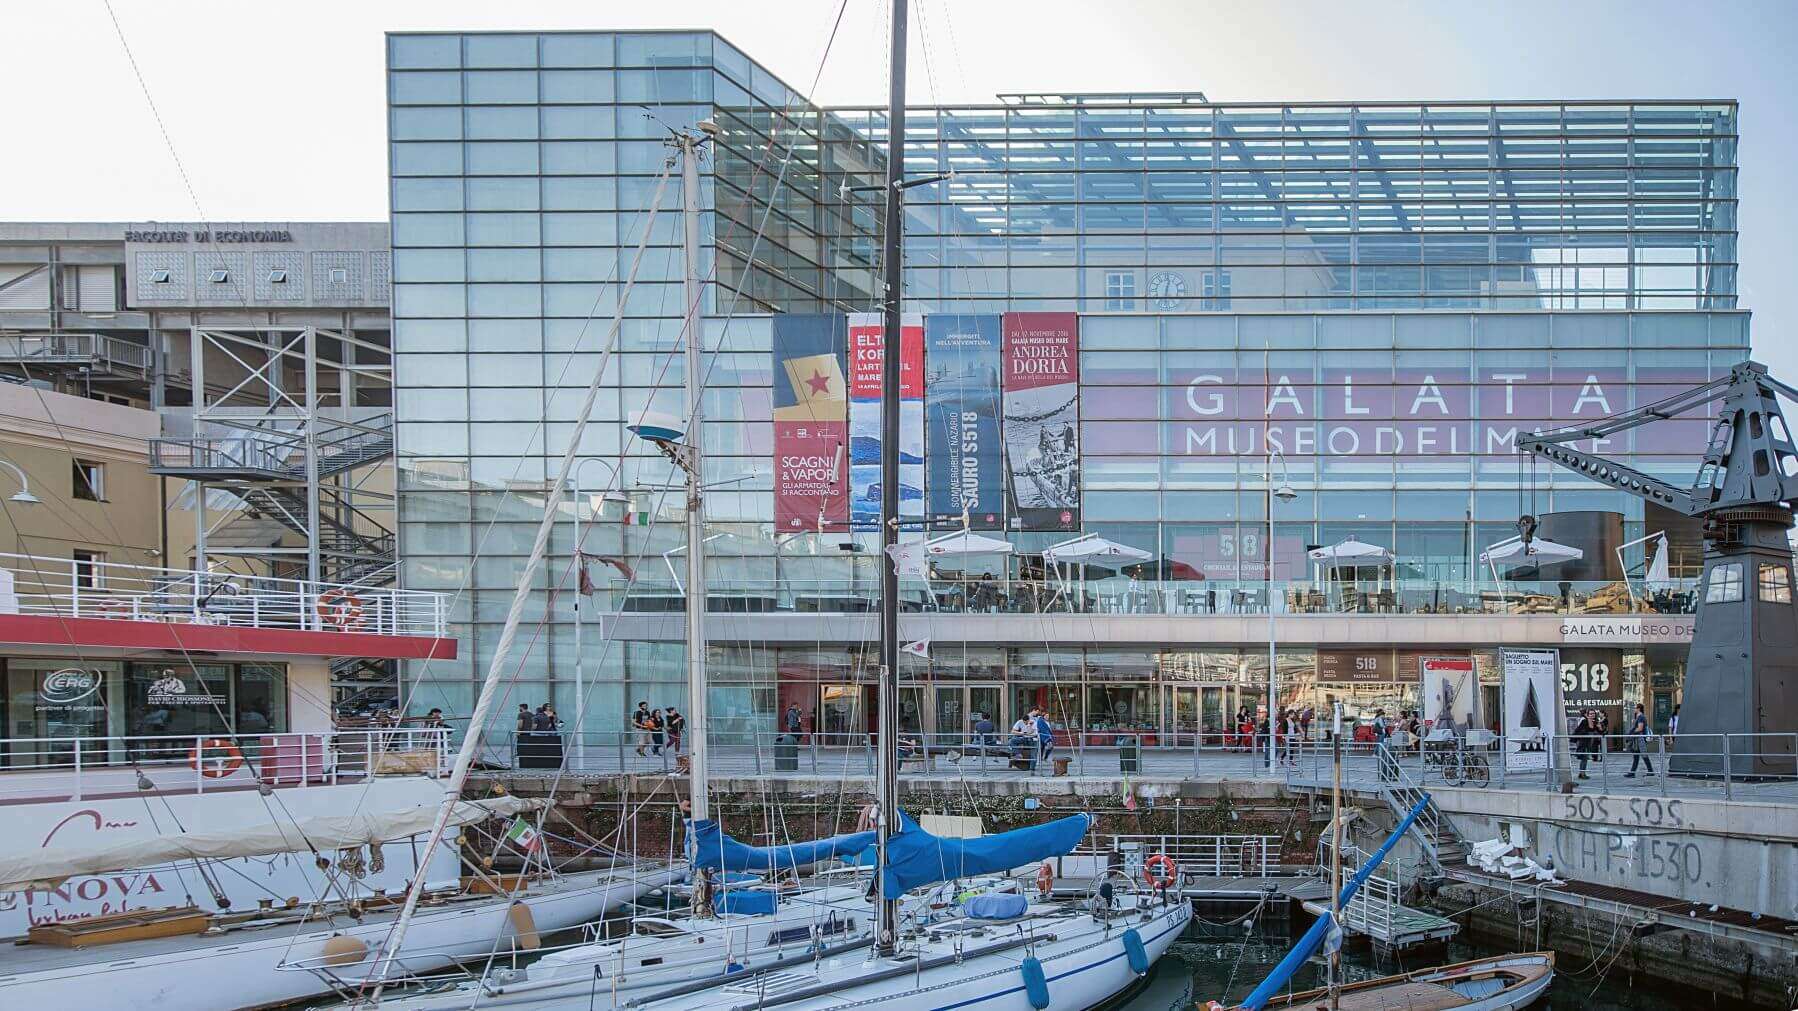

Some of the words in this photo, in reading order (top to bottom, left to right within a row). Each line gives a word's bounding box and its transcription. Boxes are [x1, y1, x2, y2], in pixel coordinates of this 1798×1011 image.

[194, 231, 209, 242] DI
[216, 231, 293, 242] ECONOMIA
[1012, 346, 1069, 358] ANDREA
[1013, 358, 1070, 374] DORIA
[1187, 375, 1611, 415] GALATA
[950, 412, 959, 446] NAZARIO
[1487, 427, 1612, 454] MRE
[782, 456, 834, 468] SCAGNI
[782, 471, 790, 481] &
[951, 449, 959, 508] SOMMERGIBILE
[962, 457, 979, 509] SAURO
[1219, 534, 1258, 557] 58
[1560, 624, 1615, 636] GALATA
[1620, 624, 1670, 636] MUSEO
[1356, 657, 1377, 670] 518
[1561, 663, 1610, 692] 518
